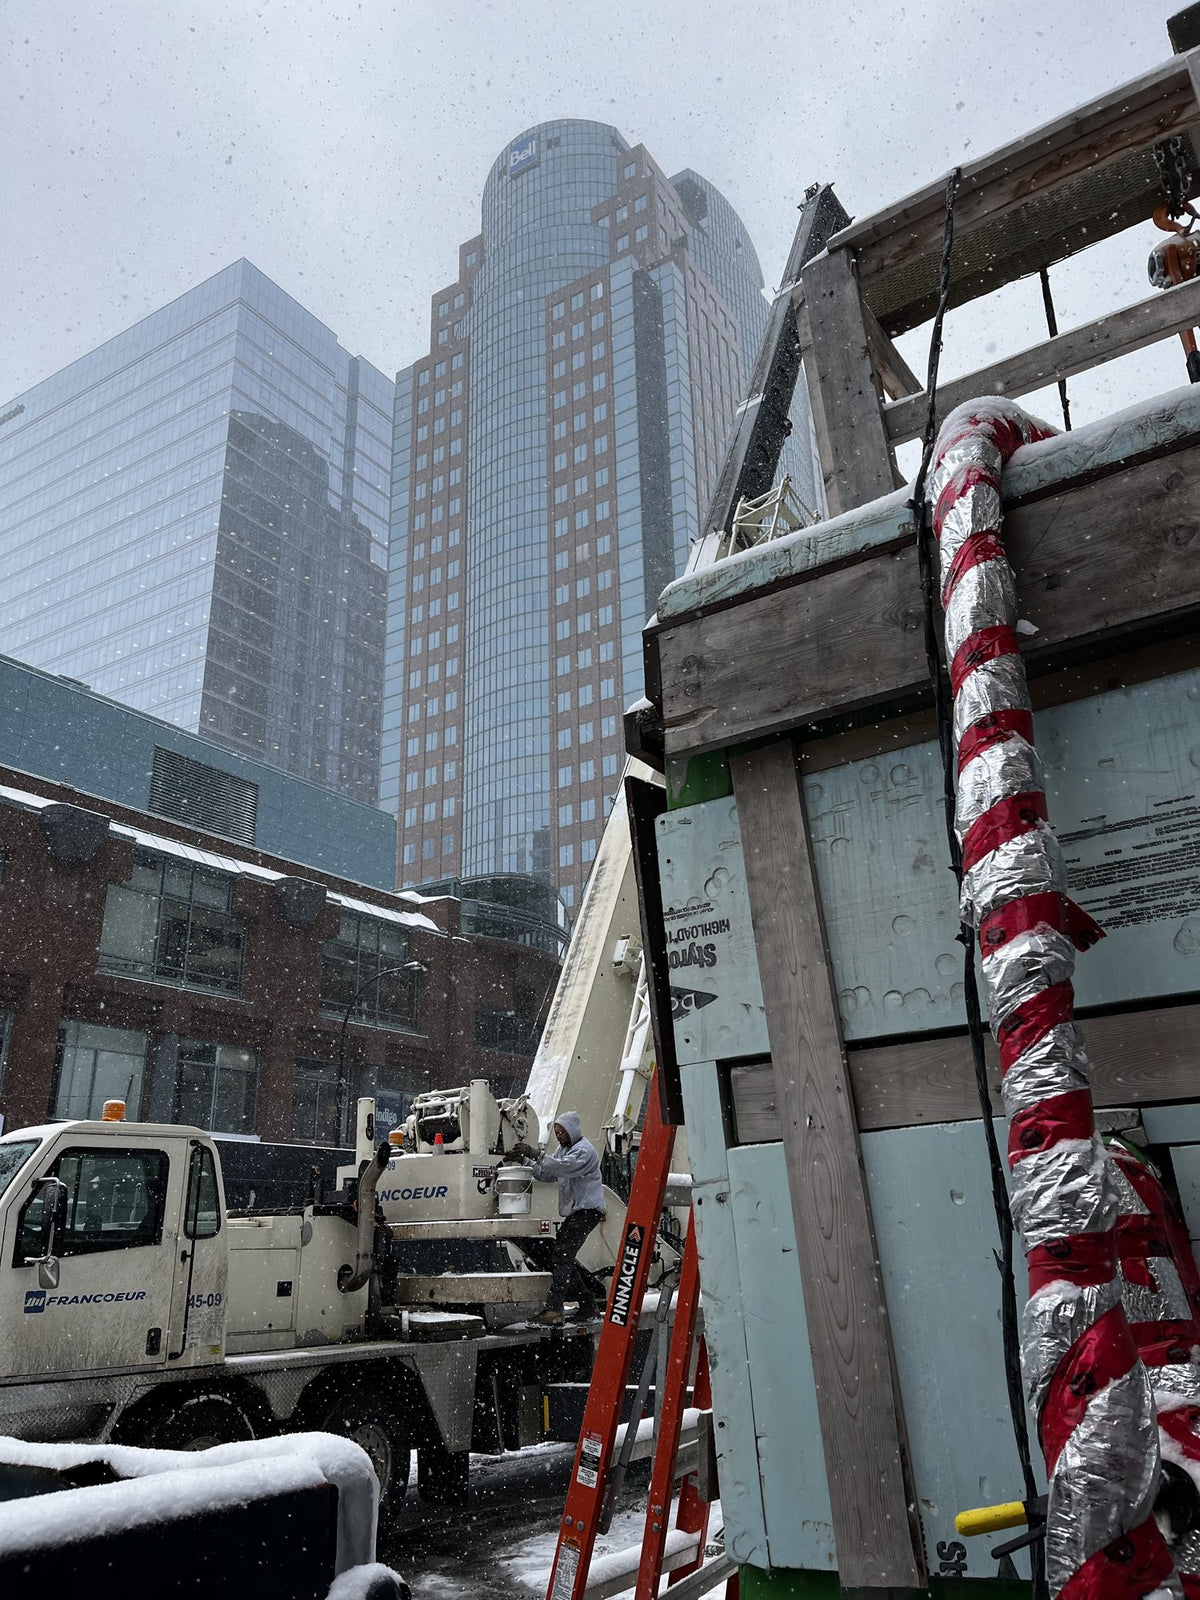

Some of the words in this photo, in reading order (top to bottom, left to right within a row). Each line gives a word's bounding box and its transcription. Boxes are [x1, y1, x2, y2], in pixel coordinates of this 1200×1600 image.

[510, 140, 536, 168] Bell
[668, 942, 718, 970] Styro
[375, 1107, 398, 1126] Indigo
[375, 1186, 448, 1202] NCOEUR
[611, 1245, 639, 1326] PINNACLE
[46, 1291, 147, 1307] FRANCOEUR
[188, 1293, 221, 1309] 45-09
[936, 1541, 967, 1577] St
